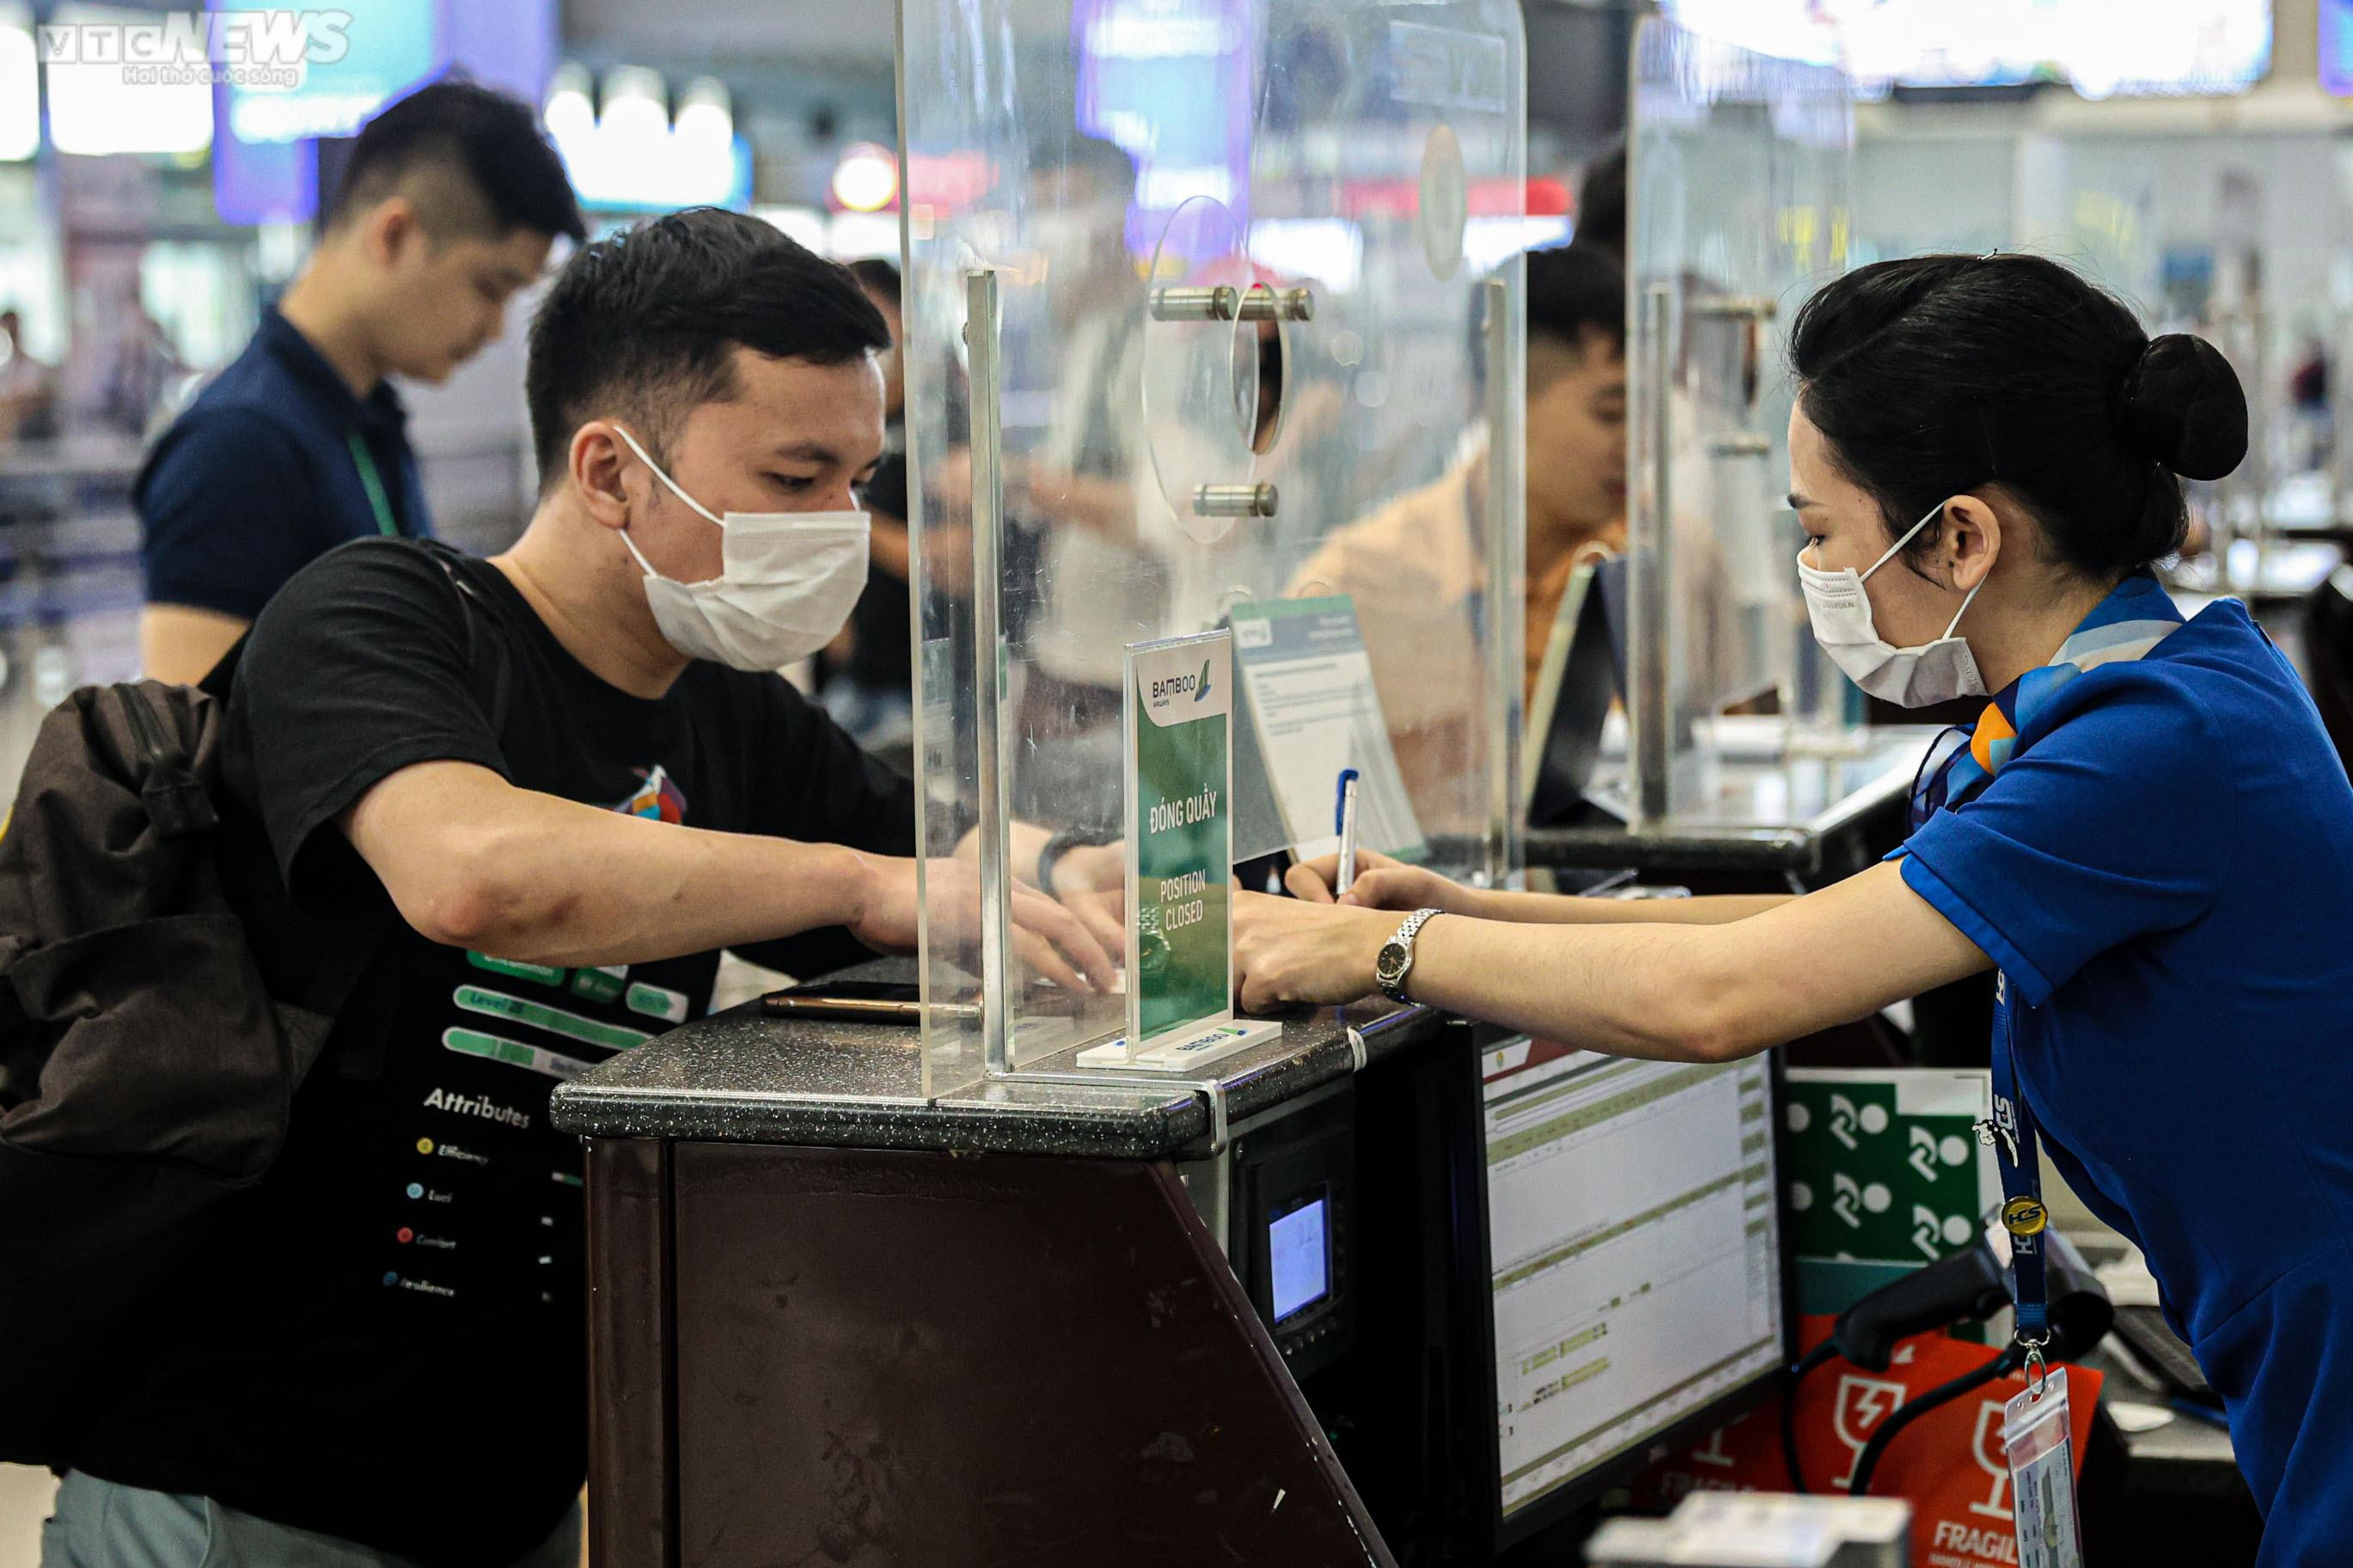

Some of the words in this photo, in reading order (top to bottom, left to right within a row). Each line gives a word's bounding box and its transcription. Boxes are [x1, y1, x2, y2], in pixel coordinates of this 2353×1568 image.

[1152, 674, 1196, 699] BAMBOO
[1149, 796, 1184, 834] ĐÓNG
[1160, 869, 1206, 904] POSITION
[1165, 900, 1204, 931] CLOSED
[423, 1087, 530, 1129] Attributes
[1934, 1520, 2020, 1565] FRAGIL
